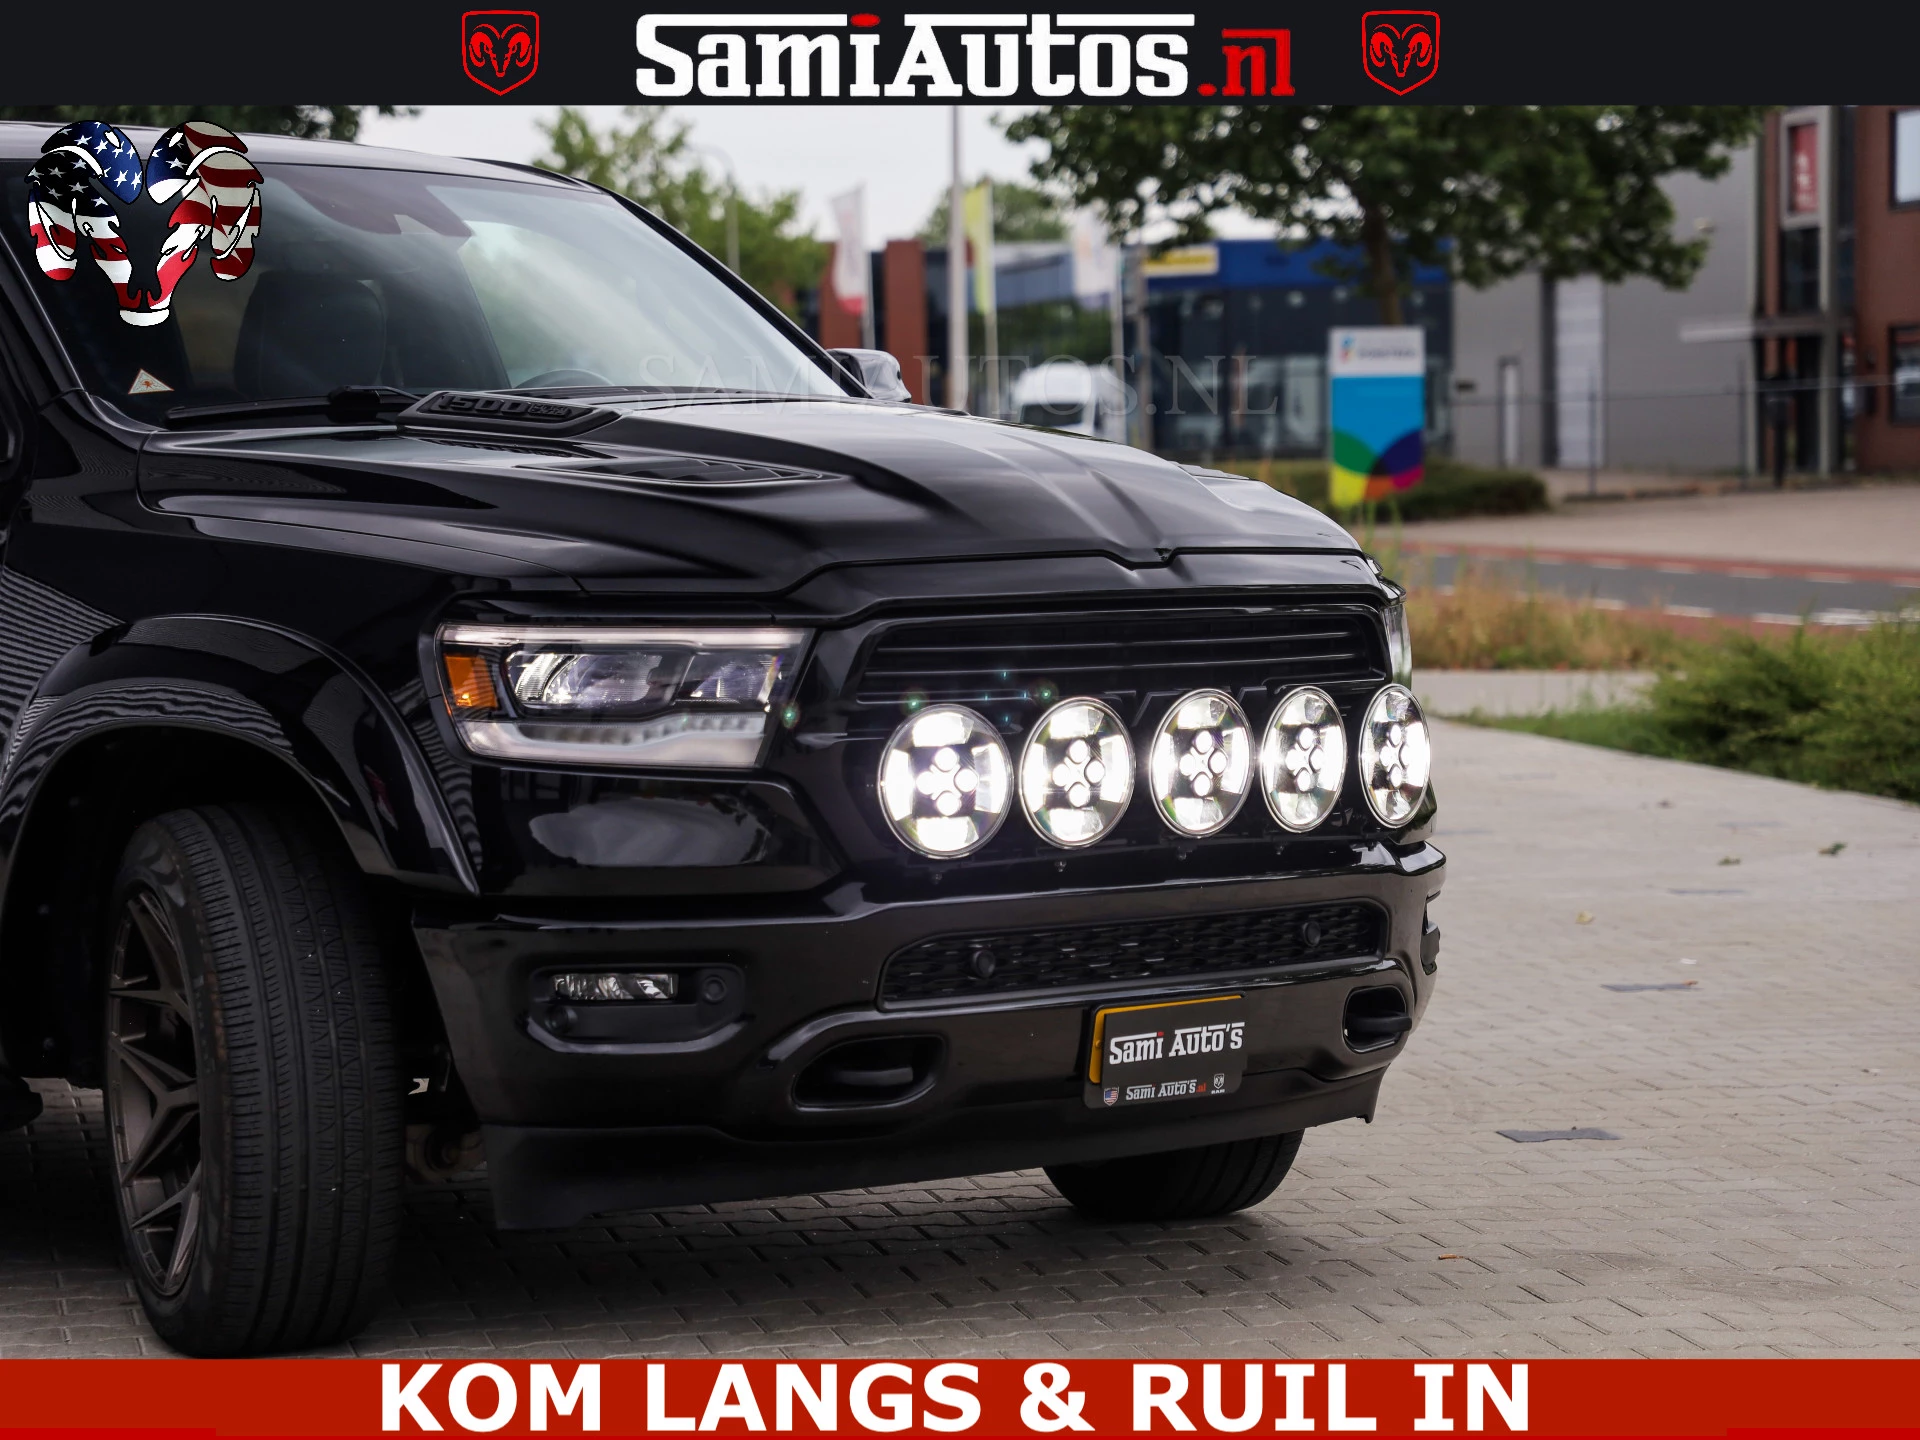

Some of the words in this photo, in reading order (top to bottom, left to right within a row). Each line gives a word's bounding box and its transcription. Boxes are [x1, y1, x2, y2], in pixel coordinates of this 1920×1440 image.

[431, 393, 528, 415] 1500
[1109, 1031, 1164, 1065] Sami
[1168, 1022, 1246, 1057] Auto's
[1126, 1083, 1156, 1101] Sami
